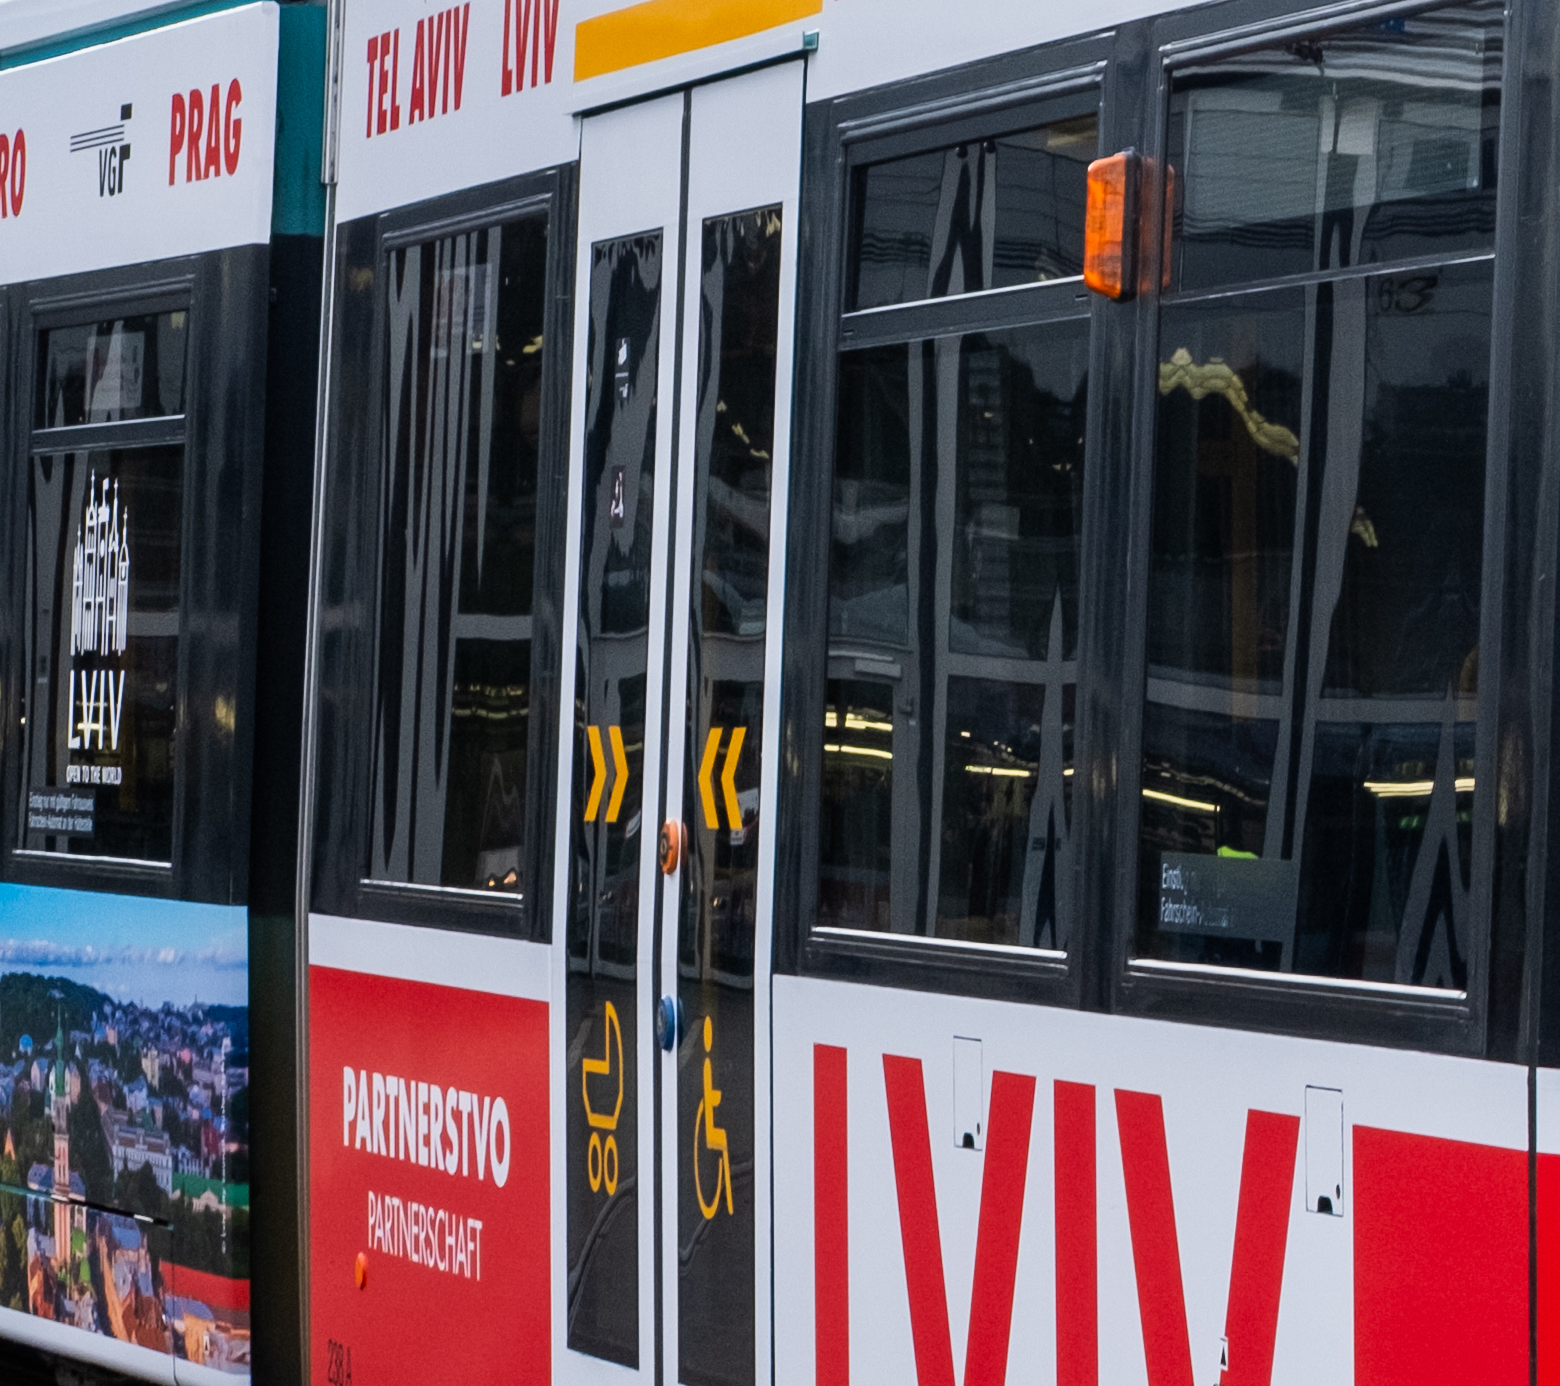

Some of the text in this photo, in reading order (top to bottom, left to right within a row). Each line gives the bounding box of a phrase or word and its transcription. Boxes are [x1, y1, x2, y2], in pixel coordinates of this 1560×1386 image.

[366, 29, 401, 139] TEL
[409, 3, 470, 125] AVIV
[99, 143, 131, 197] VGF
[168, 78, 242, 186] PRAG
[67, 669, 125, 750] LVIV
[343, 1066, 511, 1188] PARTNERSTVO
[368, 1190, 483, 1281] PARTNERSCHAFT
